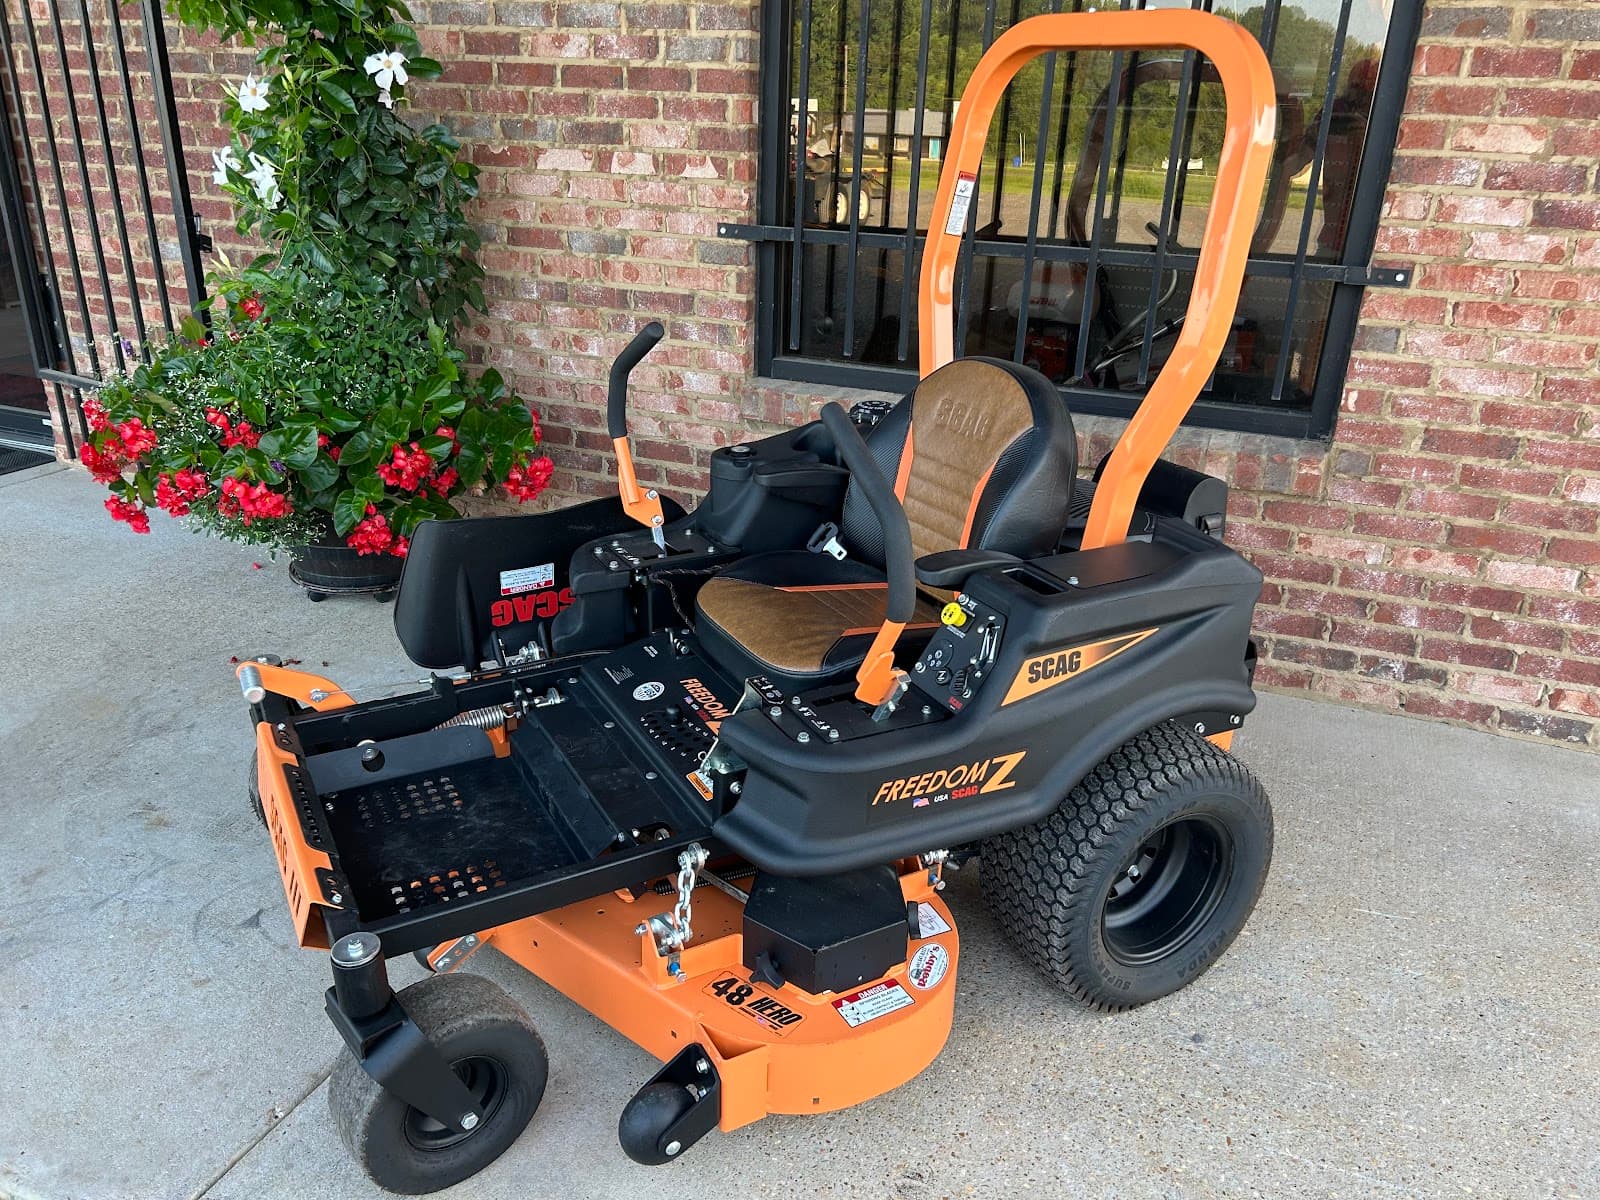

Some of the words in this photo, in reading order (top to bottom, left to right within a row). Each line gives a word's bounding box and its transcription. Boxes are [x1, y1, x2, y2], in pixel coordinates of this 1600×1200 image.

[490, 587, 577, 627] SCAG
[1028, 650, 1082, 684] SCAG
[680, 678, 732, 719] FREEDOM
[934, 793, 949, 802] USA
[951, 785, 978, 800] SCAG
[712, 977, 754, 1006] 48
[746, 996, 803, 1025] HERO
[857, 984, 889, 999] DANGER
